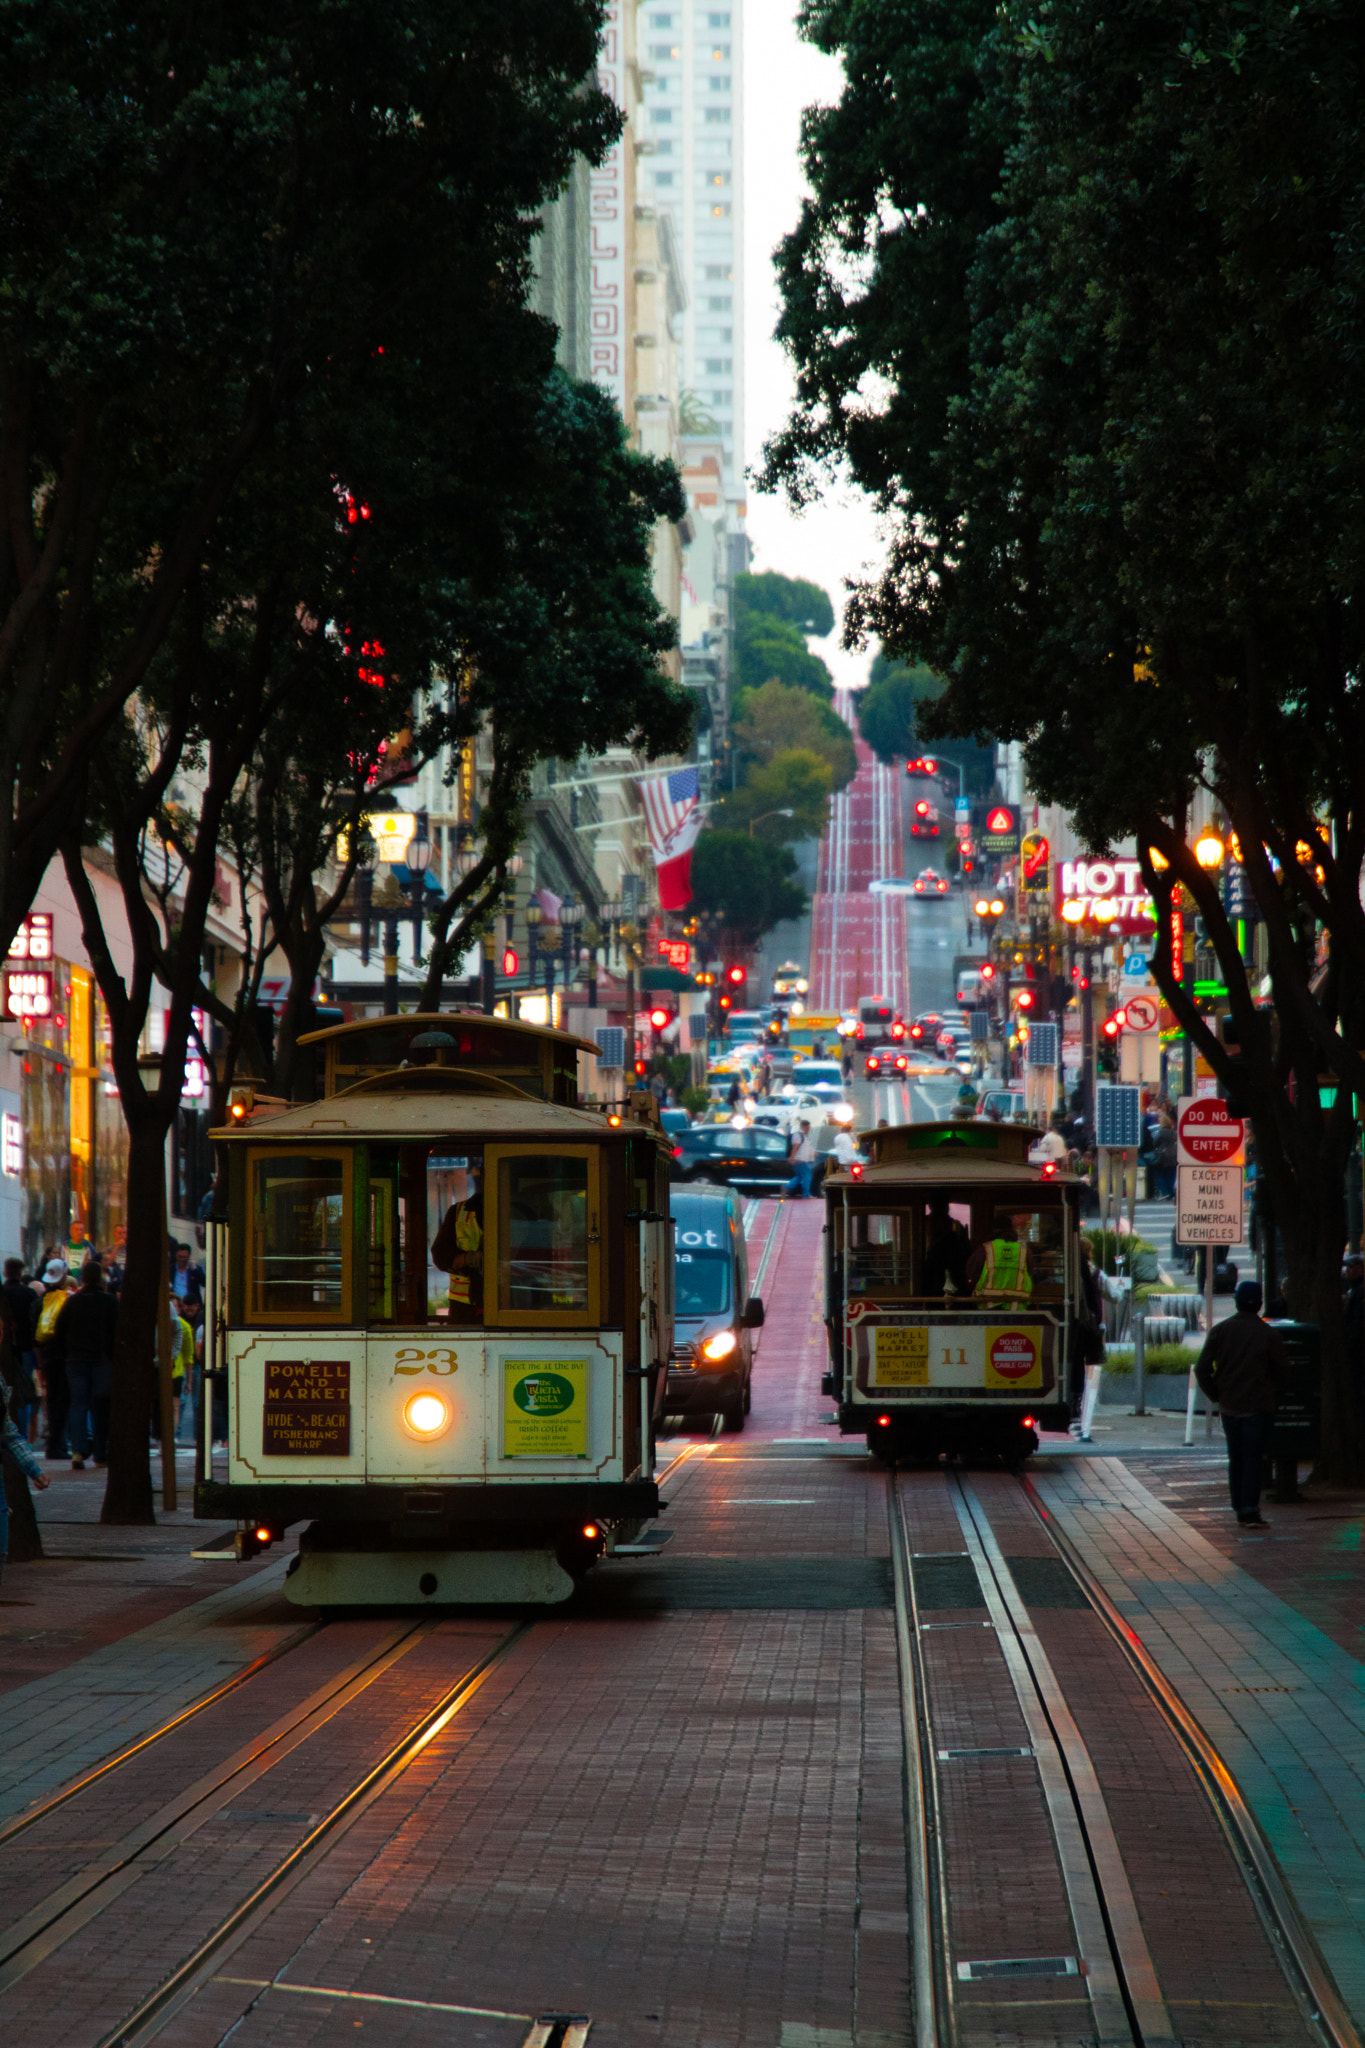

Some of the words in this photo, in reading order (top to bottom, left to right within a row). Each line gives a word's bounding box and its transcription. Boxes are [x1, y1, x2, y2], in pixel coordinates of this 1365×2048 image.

[1062, 862, 1141, 894] HOT
[8, 975, 47, 994] UNI
[8, 994, 49, 1016] QLO
[1188, 1111, 1205, 1122] DO
[1211, 1111, 1233, 1122] NO
[1192, 1140, 1230, 1151] ENTER
[1191, 1170, 1229, 1181] EXCEPT
[1198, 1185, 1223, 1195] MUNI
[1196, 1200, 1225, 1210] TAXIS
[1181, 1213, 1239, 1225] COMMERCIAL
[1186, 1228, 1234, 1239] VEHICLES
[878, 1331, 925, 1339] POWELL
[999, 1338, 1010, 1346] DO
[1011, 1338, 1027, 1346] NOT
[394, 1348, 459, 1376] 23
[941, 1348, 969, 1365] 11
[270, 1366, 347, 1377] POWELL
[290, 1378, 329, 1387] AND
[268, 1388, 349, 1400] MARKET
[267, 1413, 294, 1427] HYDE
[311, 1414, 347, 1428] BEACH
[273, 1429, 339, 1440] FISHERMANS
[288, 1440, 322, 1449] WHARF
